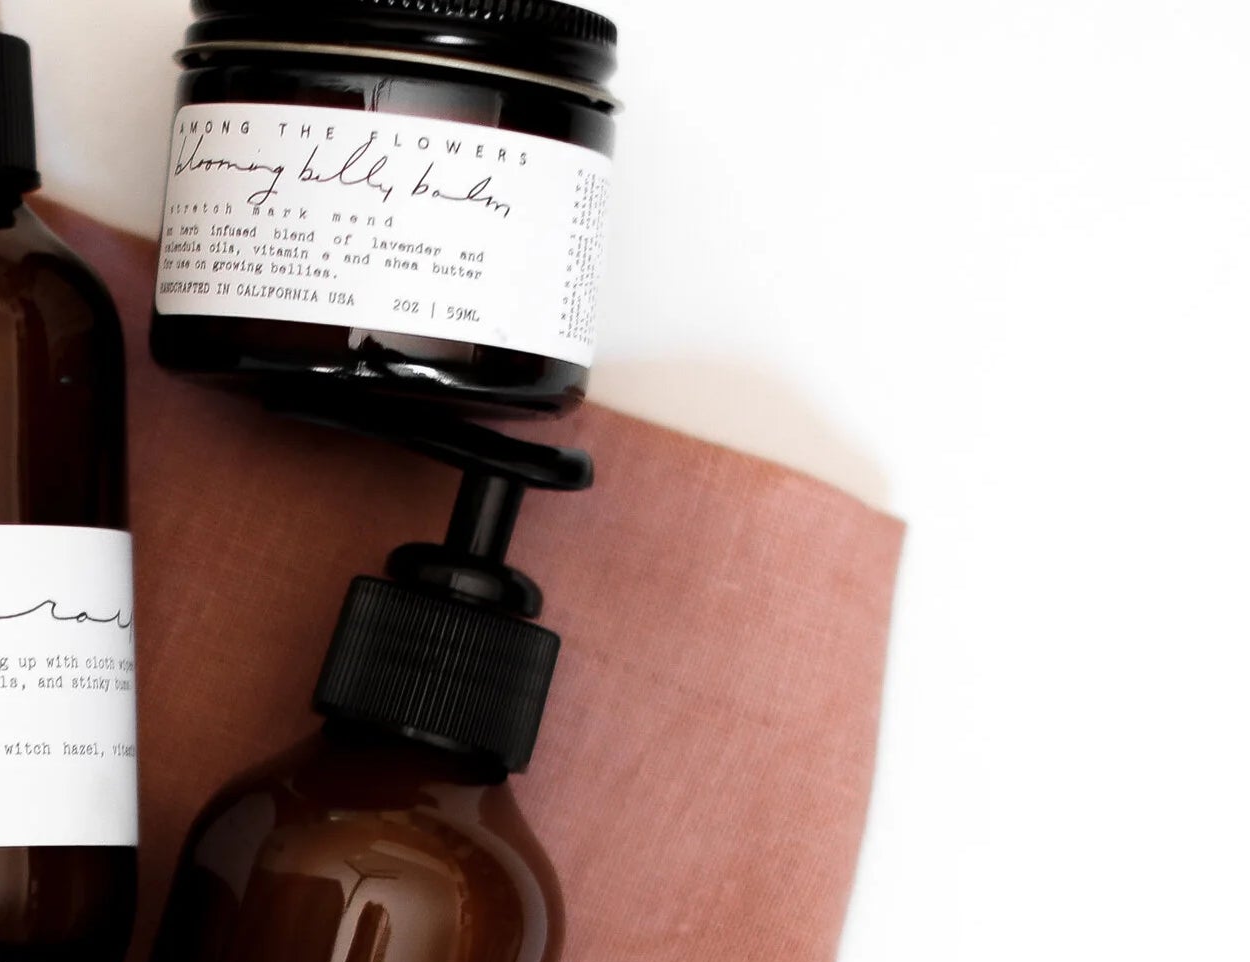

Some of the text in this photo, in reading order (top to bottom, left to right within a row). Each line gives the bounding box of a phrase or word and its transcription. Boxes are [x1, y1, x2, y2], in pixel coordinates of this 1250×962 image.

[179, 119, 526, 165] AMONG THE FLOWERS
[174, 131, 510, 218] blooming belly balm
[252, 200, 306, 219] mark
[330, 211, 394, 228] mend
[209, 222, 485, 263] infused blend of lavender and
[209, 240, 482, 279] oils, vitamin and shea butter
[212, 259, 337, 279] growing bellies.
[215, 281, 231, 296] IN
[236, 283, 318, 302] CALIFORNIA
[327, 290, 355, 307] USA
[447, 306, 479, 322] 59ML
[17, 656, 37, 671] up
[44, 653, 79, 670] with
[36, 674, 63, 689] and
[71, 674, 110, 692] stinky
[3, 741, 52, 756] witch
[62, 741, 104, 758] hazel,
